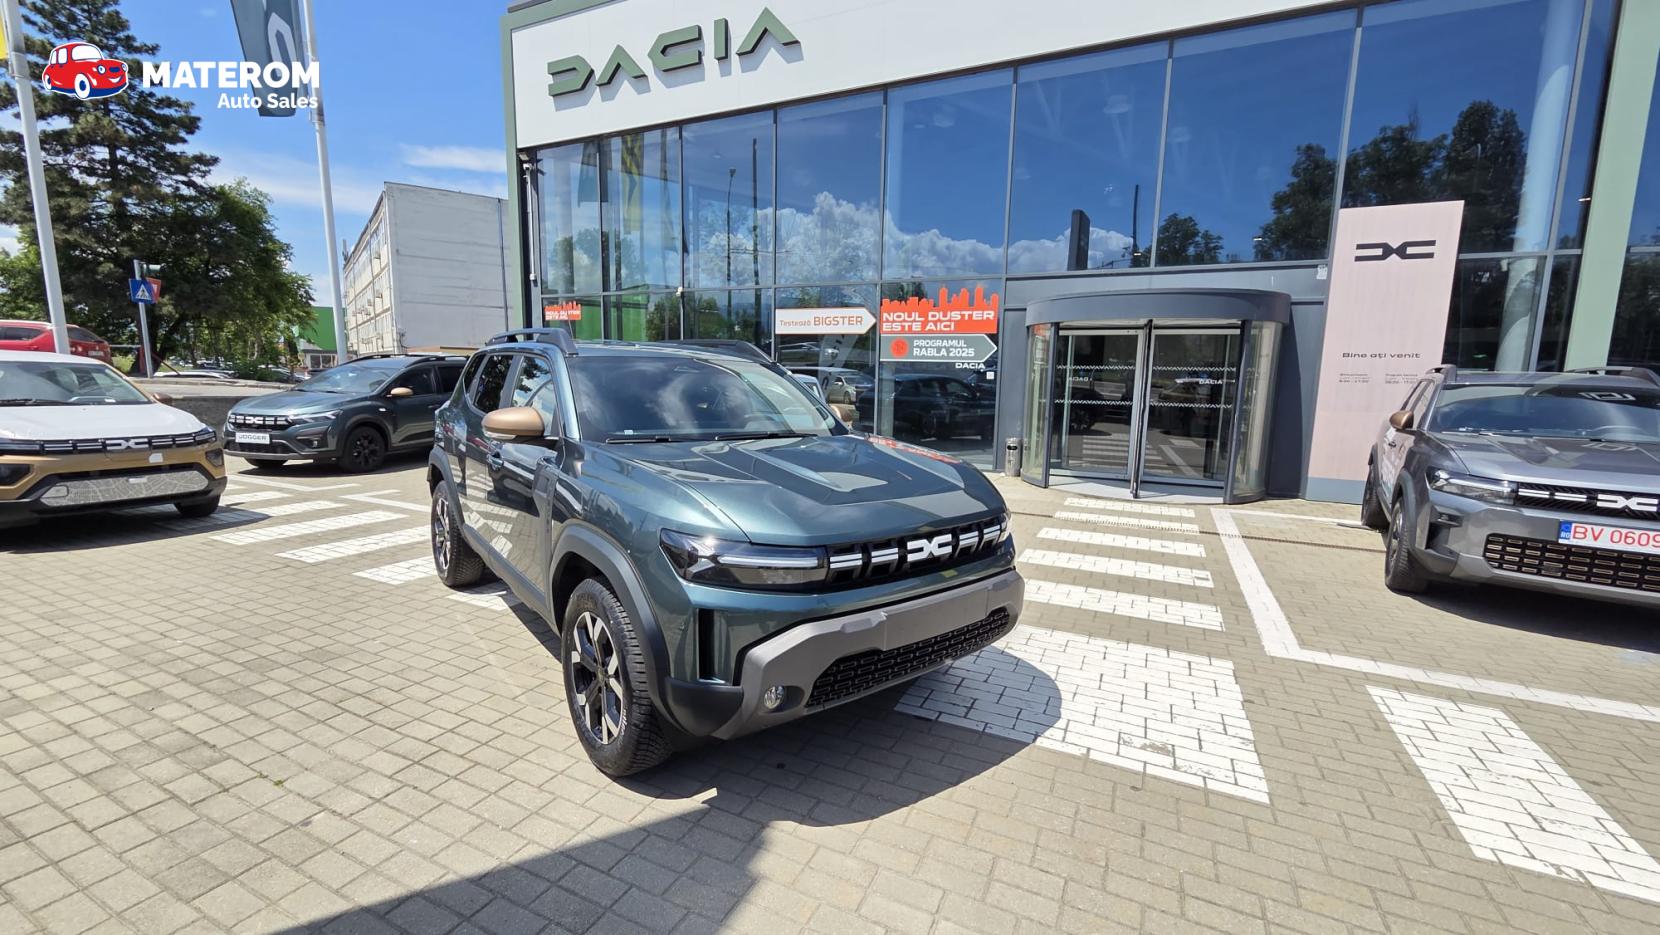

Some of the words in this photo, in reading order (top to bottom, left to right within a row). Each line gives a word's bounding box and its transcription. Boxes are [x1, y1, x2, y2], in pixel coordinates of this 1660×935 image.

[547, 7, 800, 96] DACIA
[813, 315, 864, 326] BIGSTER
[882, 311, 925, 321] NOUL
[928, 310, 995, 320] DUSTER
[882, 322, 922, 331] ESTE
[925, 321, 955, 331] AICI
[913, 339, 967, 347] PROGRAMUL
[913, 347, 947, 356] RABLA
[949, 347, 975, 357] 2025
[1573, 525, 1604, 542] BV
